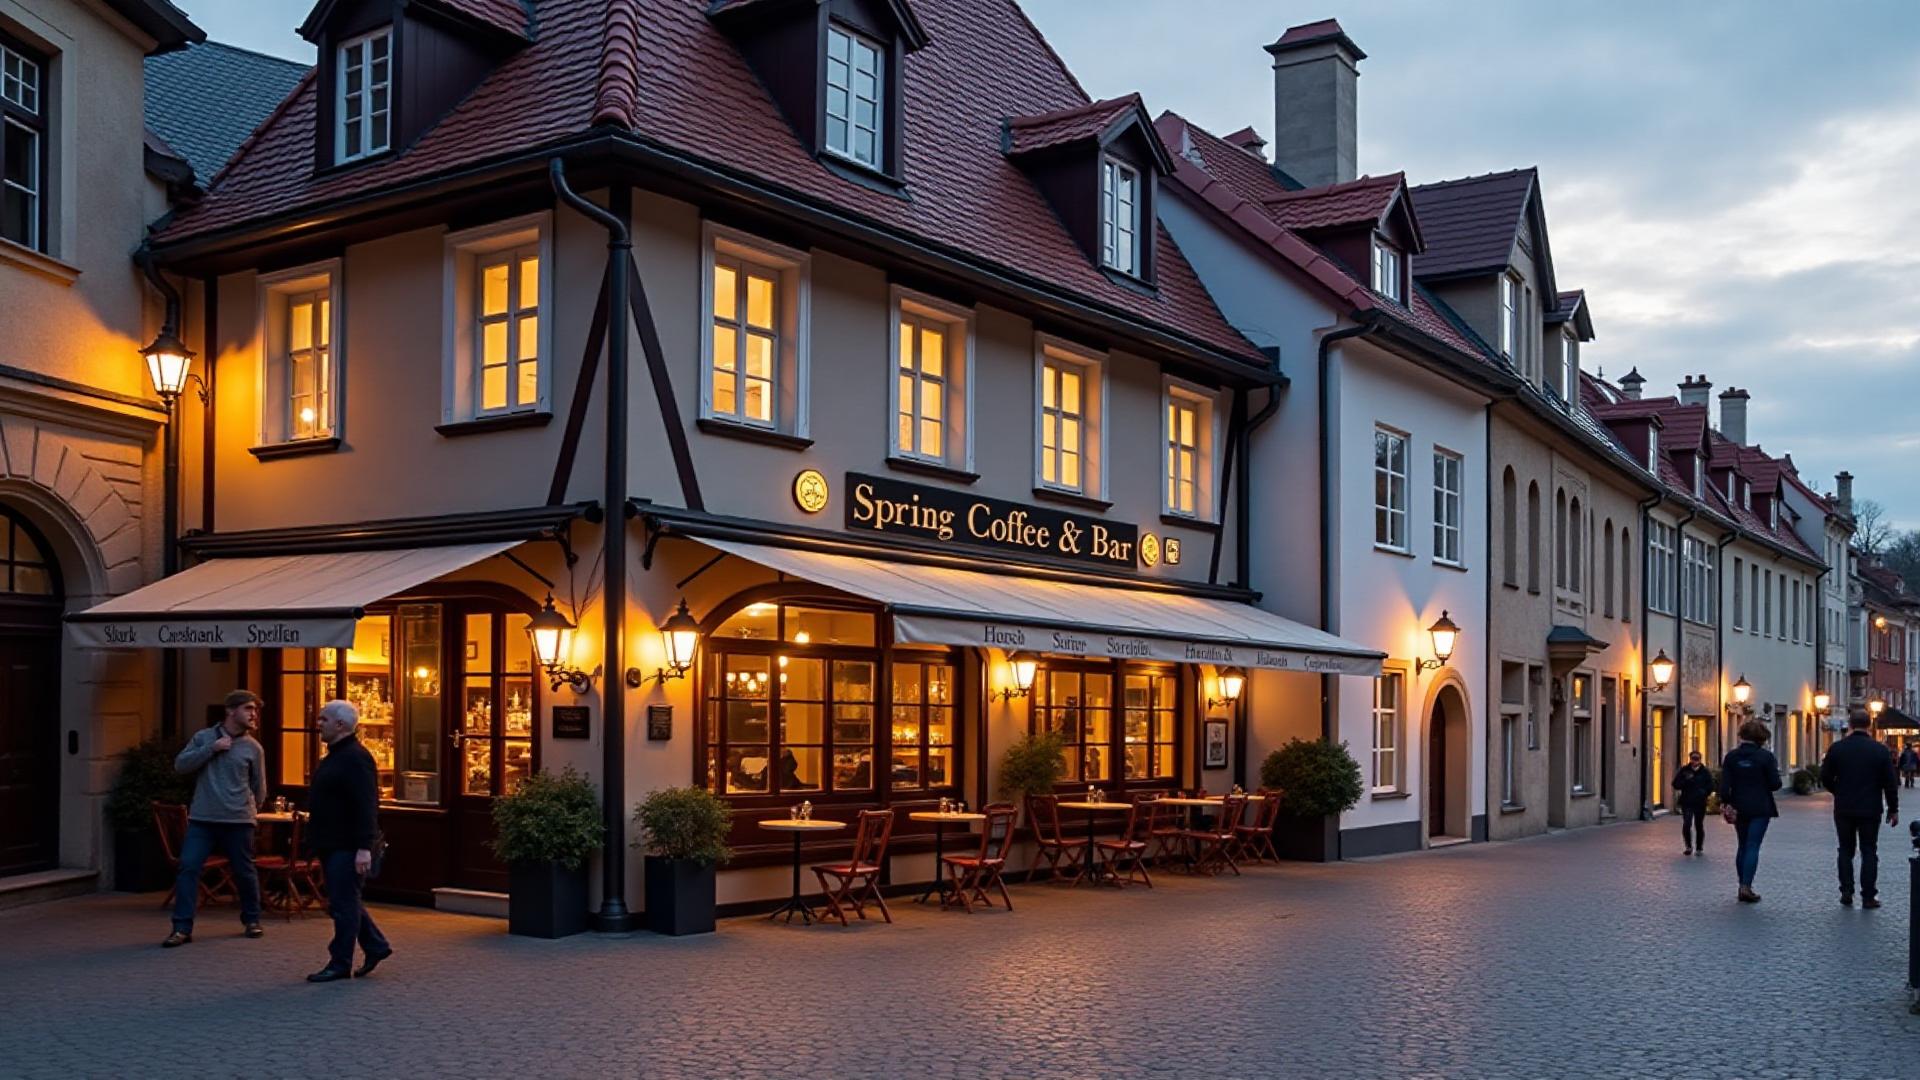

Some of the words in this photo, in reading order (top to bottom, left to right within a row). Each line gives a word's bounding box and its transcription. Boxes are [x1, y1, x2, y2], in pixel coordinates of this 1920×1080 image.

[853, 483, 955, 541] Spring
[967, 503, 1050, 548] Coffee
[1058, 519, 1084, 554] &
[1090, 524, 1132, 561] Bar
